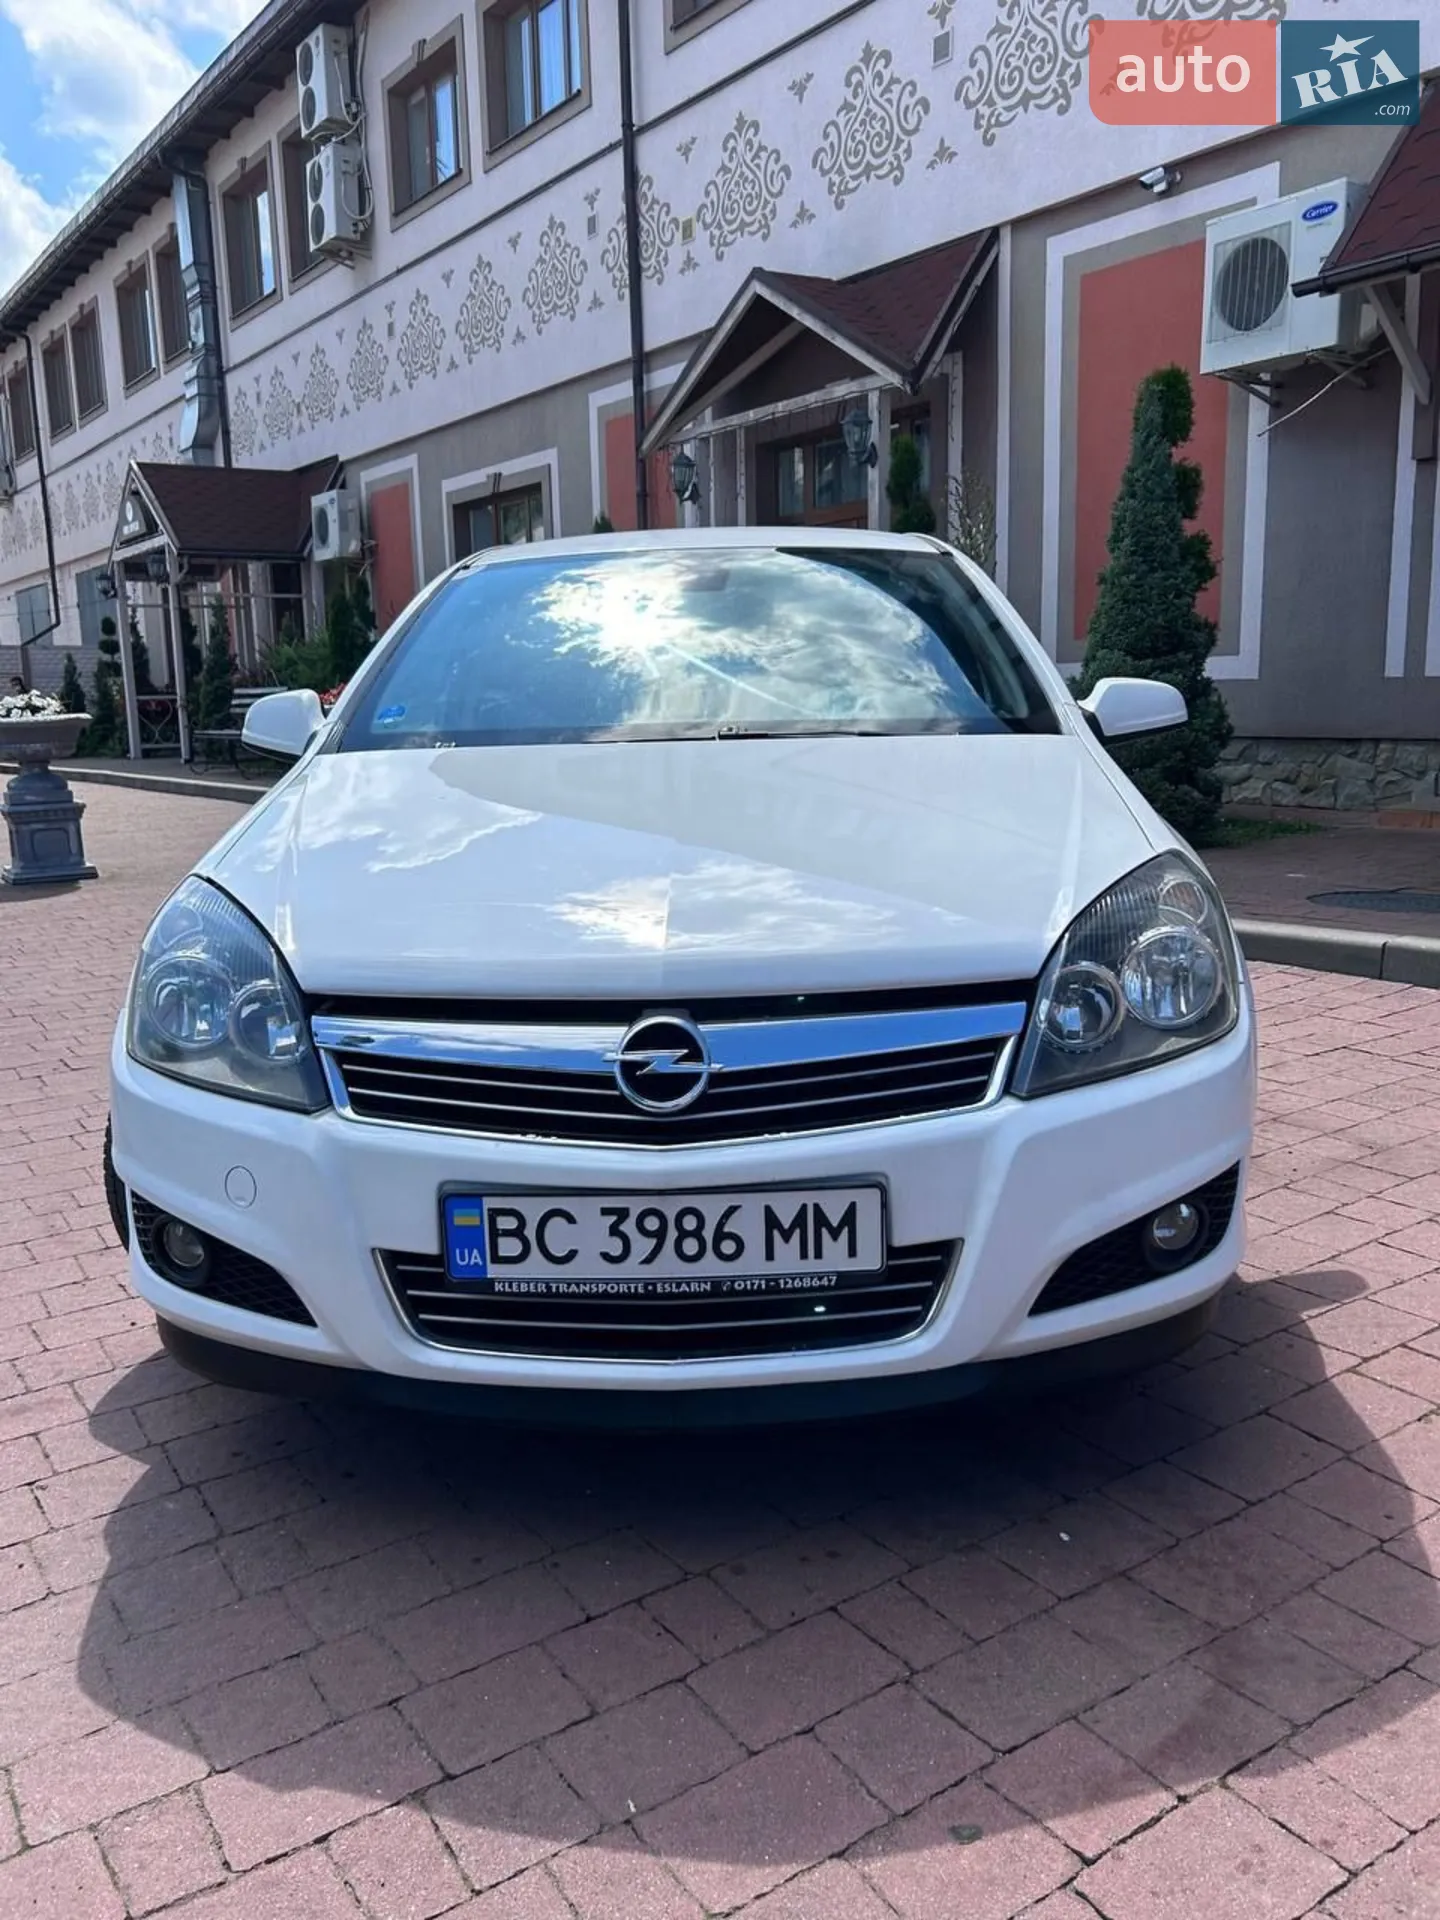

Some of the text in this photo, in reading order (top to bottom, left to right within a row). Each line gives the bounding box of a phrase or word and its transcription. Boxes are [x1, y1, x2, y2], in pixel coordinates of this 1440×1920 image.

[1305, 203, 1335, 218] Carrier
[487, 1201, 857, 1266] BC 3986 MM
[455, 1248, 483, 1266] UA
[494, 1281, 547, 1293] KLEBER
[549, 1282, 645, 1294] TRANSPORTE
[656, 1281, 711, 1293] ESLARN
[734, 1279, 766, 1290] 0171
[779, 1275, 838, 1289] 1268647
